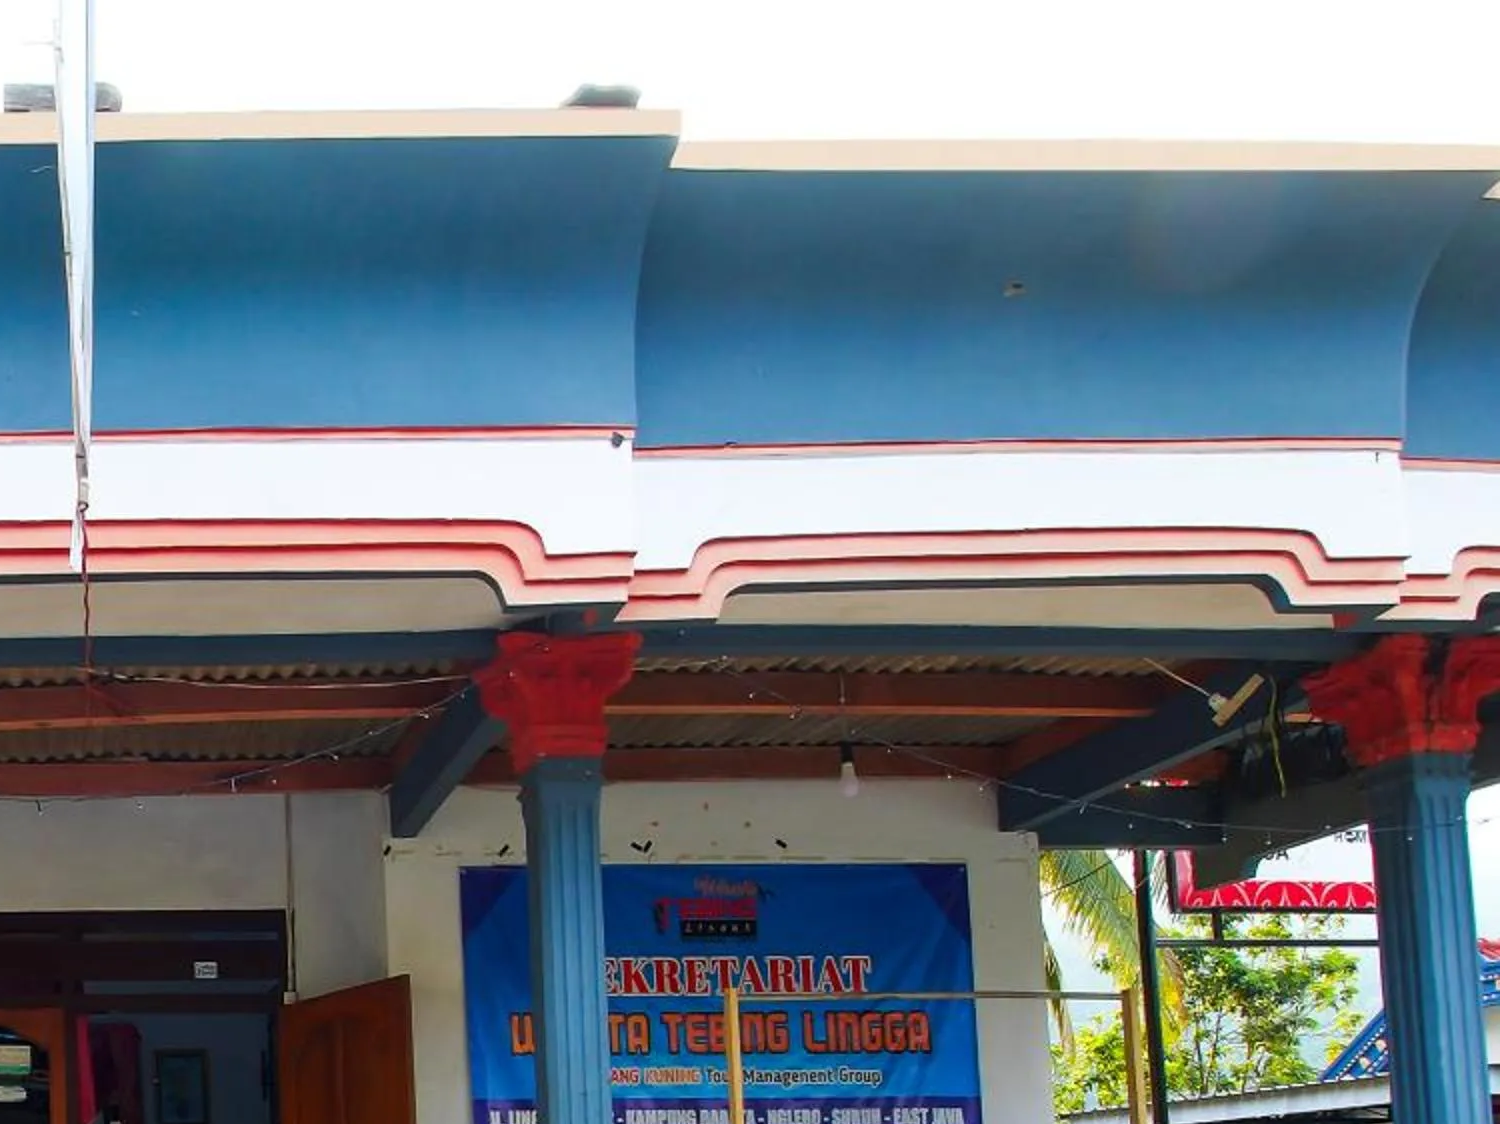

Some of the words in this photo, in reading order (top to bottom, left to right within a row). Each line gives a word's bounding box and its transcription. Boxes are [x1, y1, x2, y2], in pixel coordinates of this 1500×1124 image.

[603, 956, 872, 996] EKRETARIAT
[661, 1012, 789, 1055] TEBNG
[802, 1011, 932, 1055] LINGGA
[838, 1065, 882, 1088] Group
